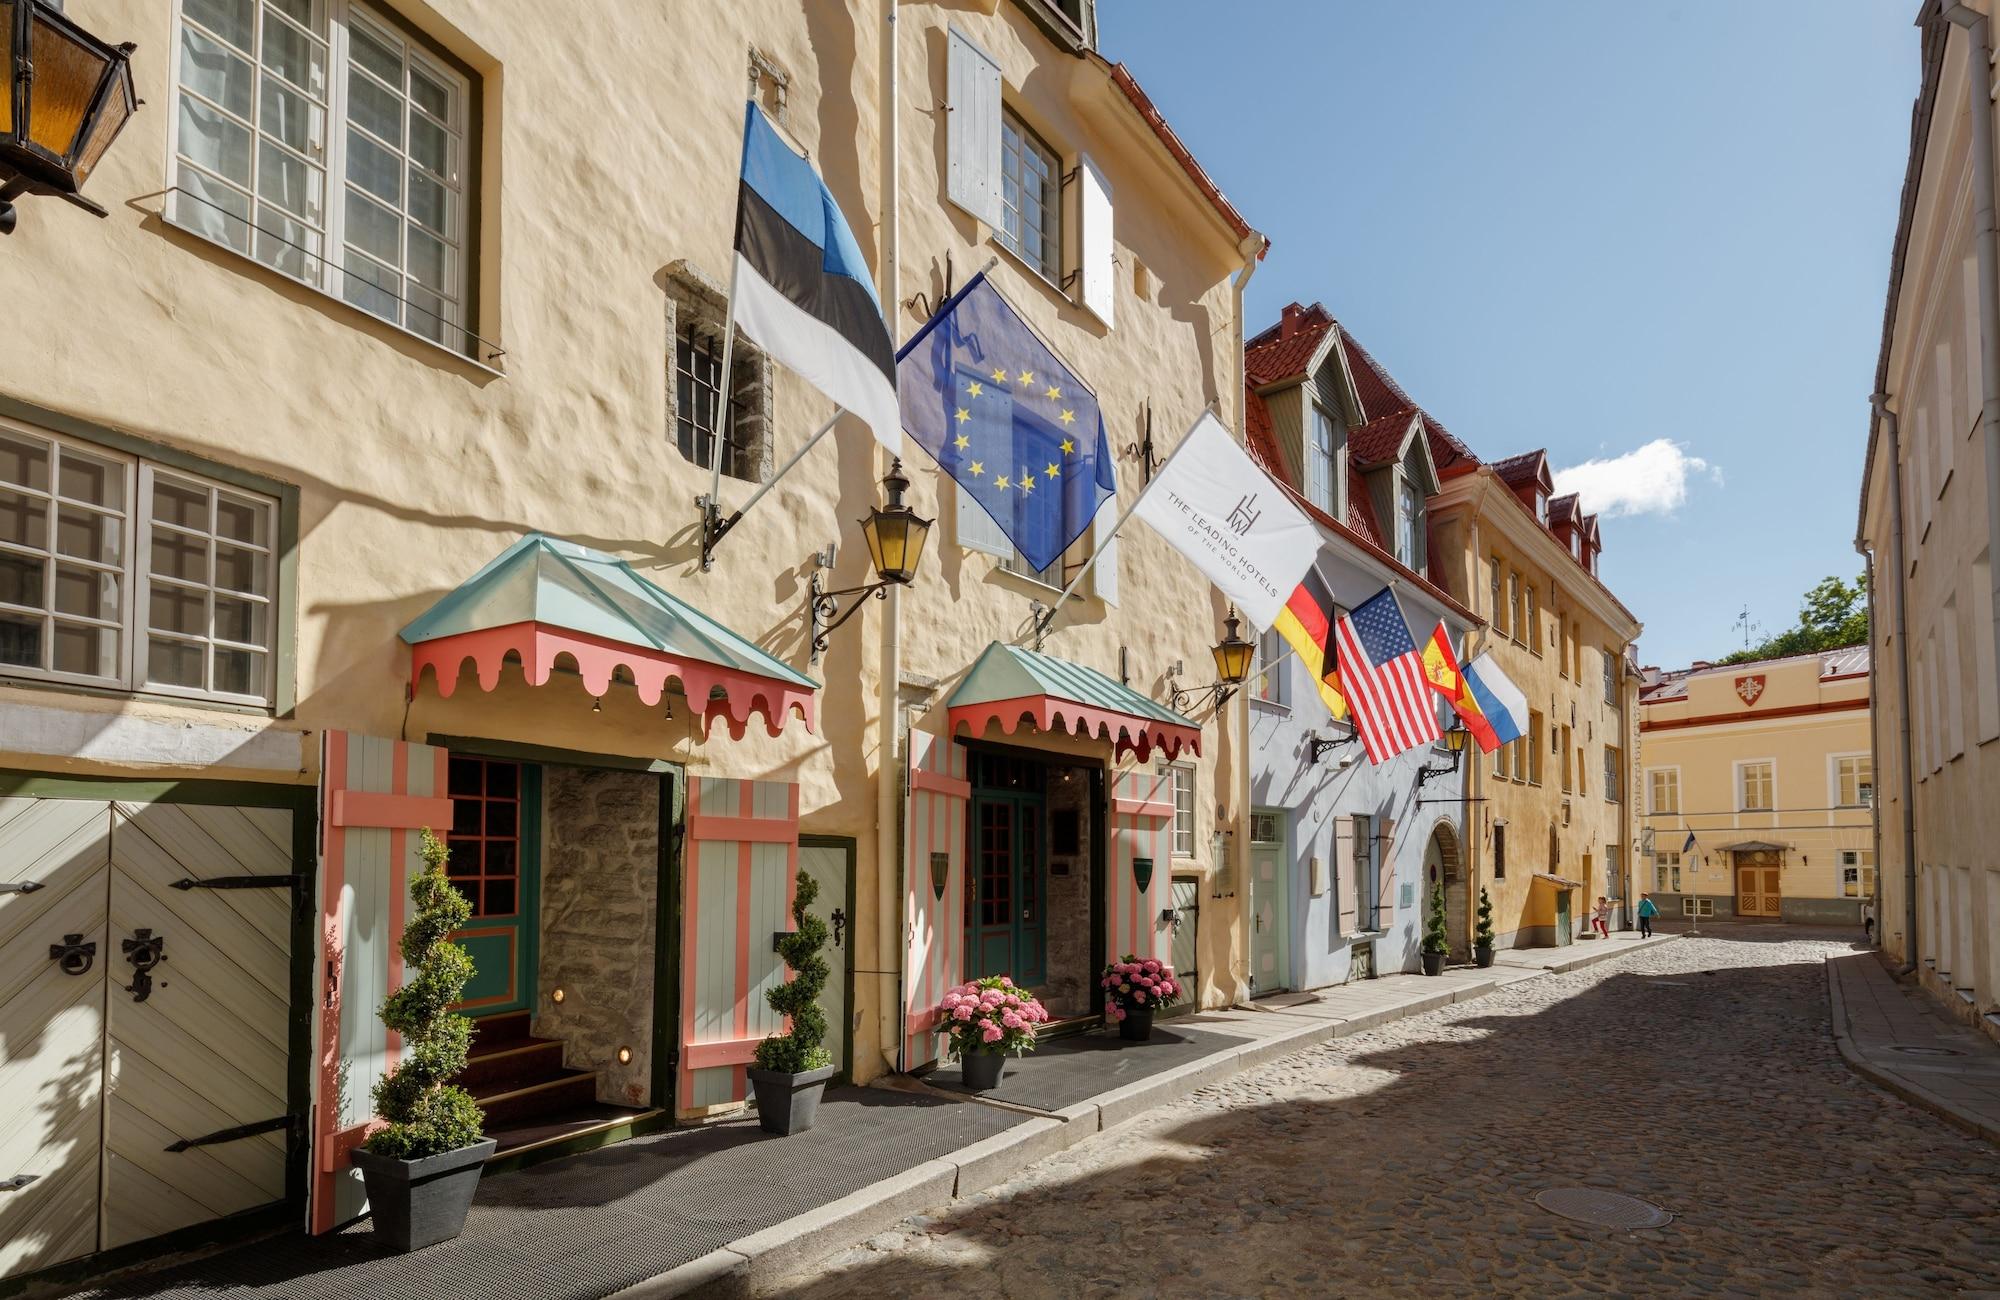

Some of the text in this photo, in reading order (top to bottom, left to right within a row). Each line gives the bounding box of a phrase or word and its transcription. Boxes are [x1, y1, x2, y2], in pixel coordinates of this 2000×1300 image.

[1168, 492, 1278, 598] THE LEADING HOTELS
[1187, 525, 1247, 581] OF THE WORLD
